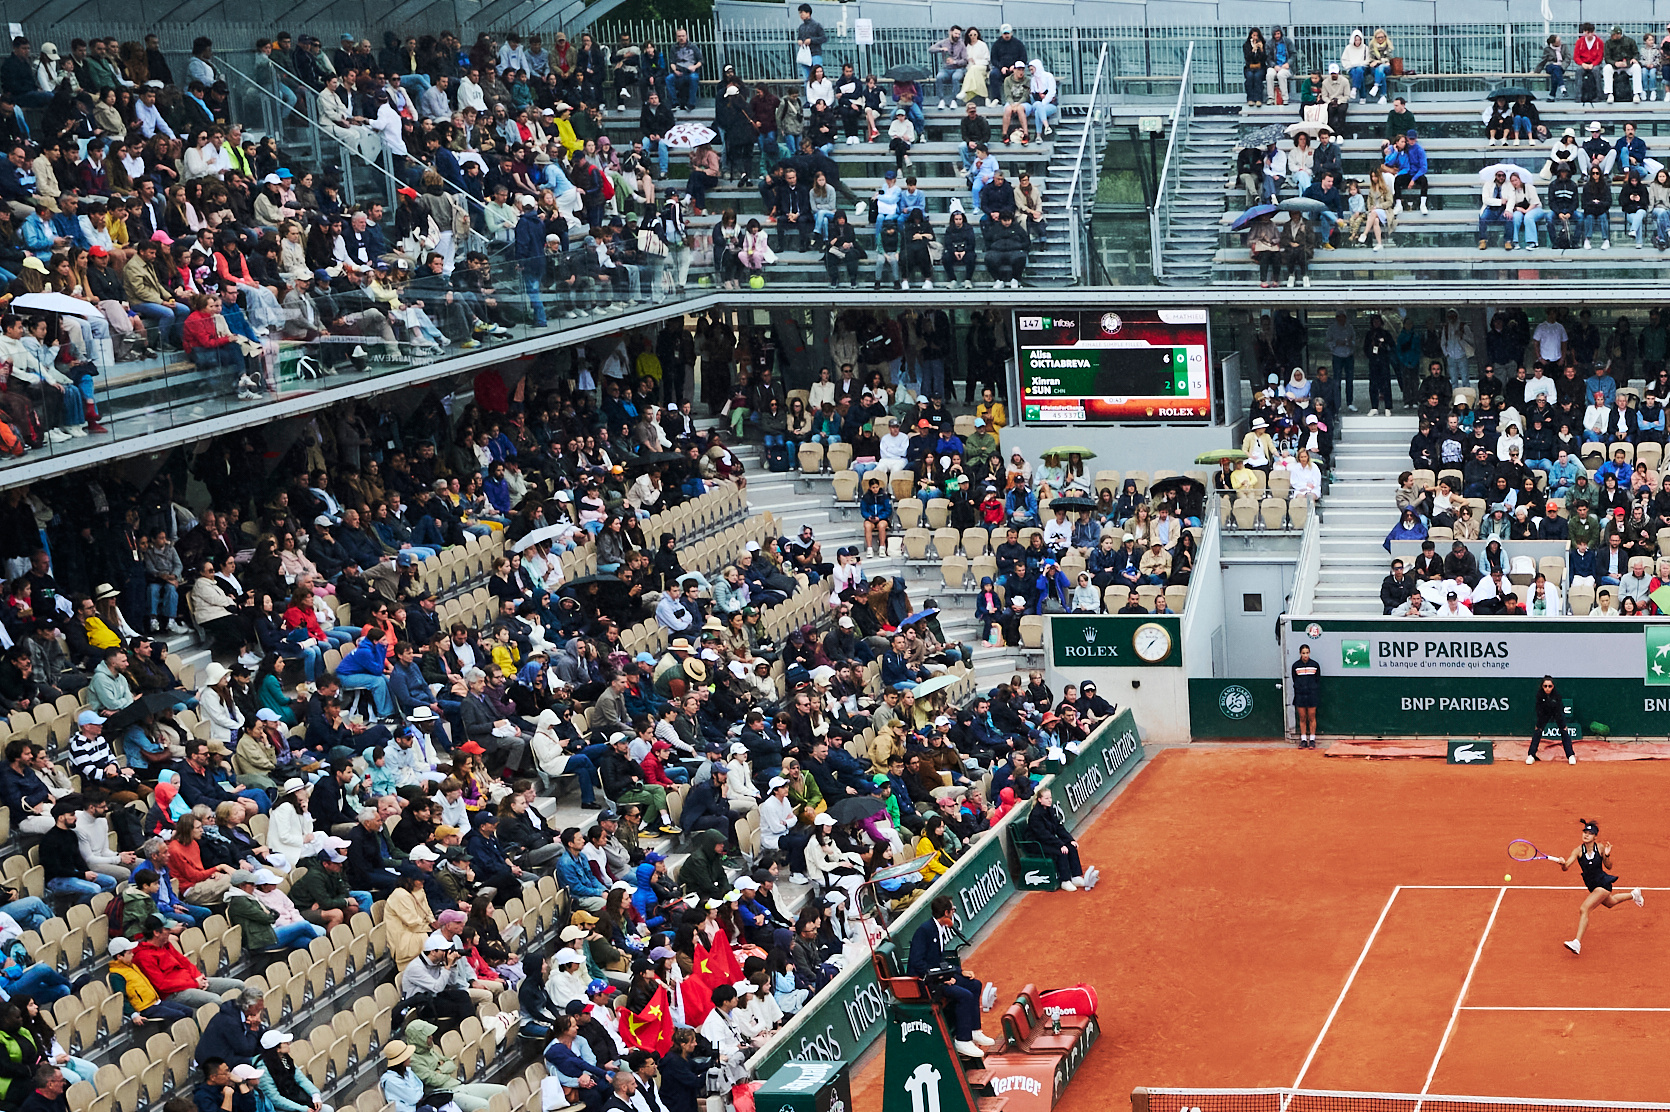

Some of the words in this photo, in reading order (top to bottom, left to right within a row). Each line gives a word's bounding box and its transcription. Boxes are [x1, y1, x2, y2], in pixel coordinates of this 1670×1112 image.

[1023, 319, 1039, 328] 147
[1030, 350, 1052, 359] Alisa
[1163, 354, 1170, 363] 6
[1177, 354, 1185, 363] 0
[1030, 359, 1091, 368] OKTIABREVA
[1031, 376, 1060, 385] Xinran
[1164, 381, 1171, 389] 2
[1178, 380, 1186, 389] 0
[1032, 386, 1051, 394] SUN
[1159, 408, 1194, 416] ROLEX
[1065, 646, 1118, 657] ROLEX
[1379, 641, 1419, 658] BNP
[1425, 641, 1509, 658] PARIBAS
[1390, 661, 1418, 669] banque
[1468, 661, 1480, 669] qui
[1482, 661, 1510, 670] change
[1401, 697, 1435, 711] BNP
[1439, 697, 1510, 711] PARIBAS
[1101, 728, 1137, 776] Emirates
[1064, 762, 1103, 813] Emirates
[959, 859, 1007, 921] Emirates
